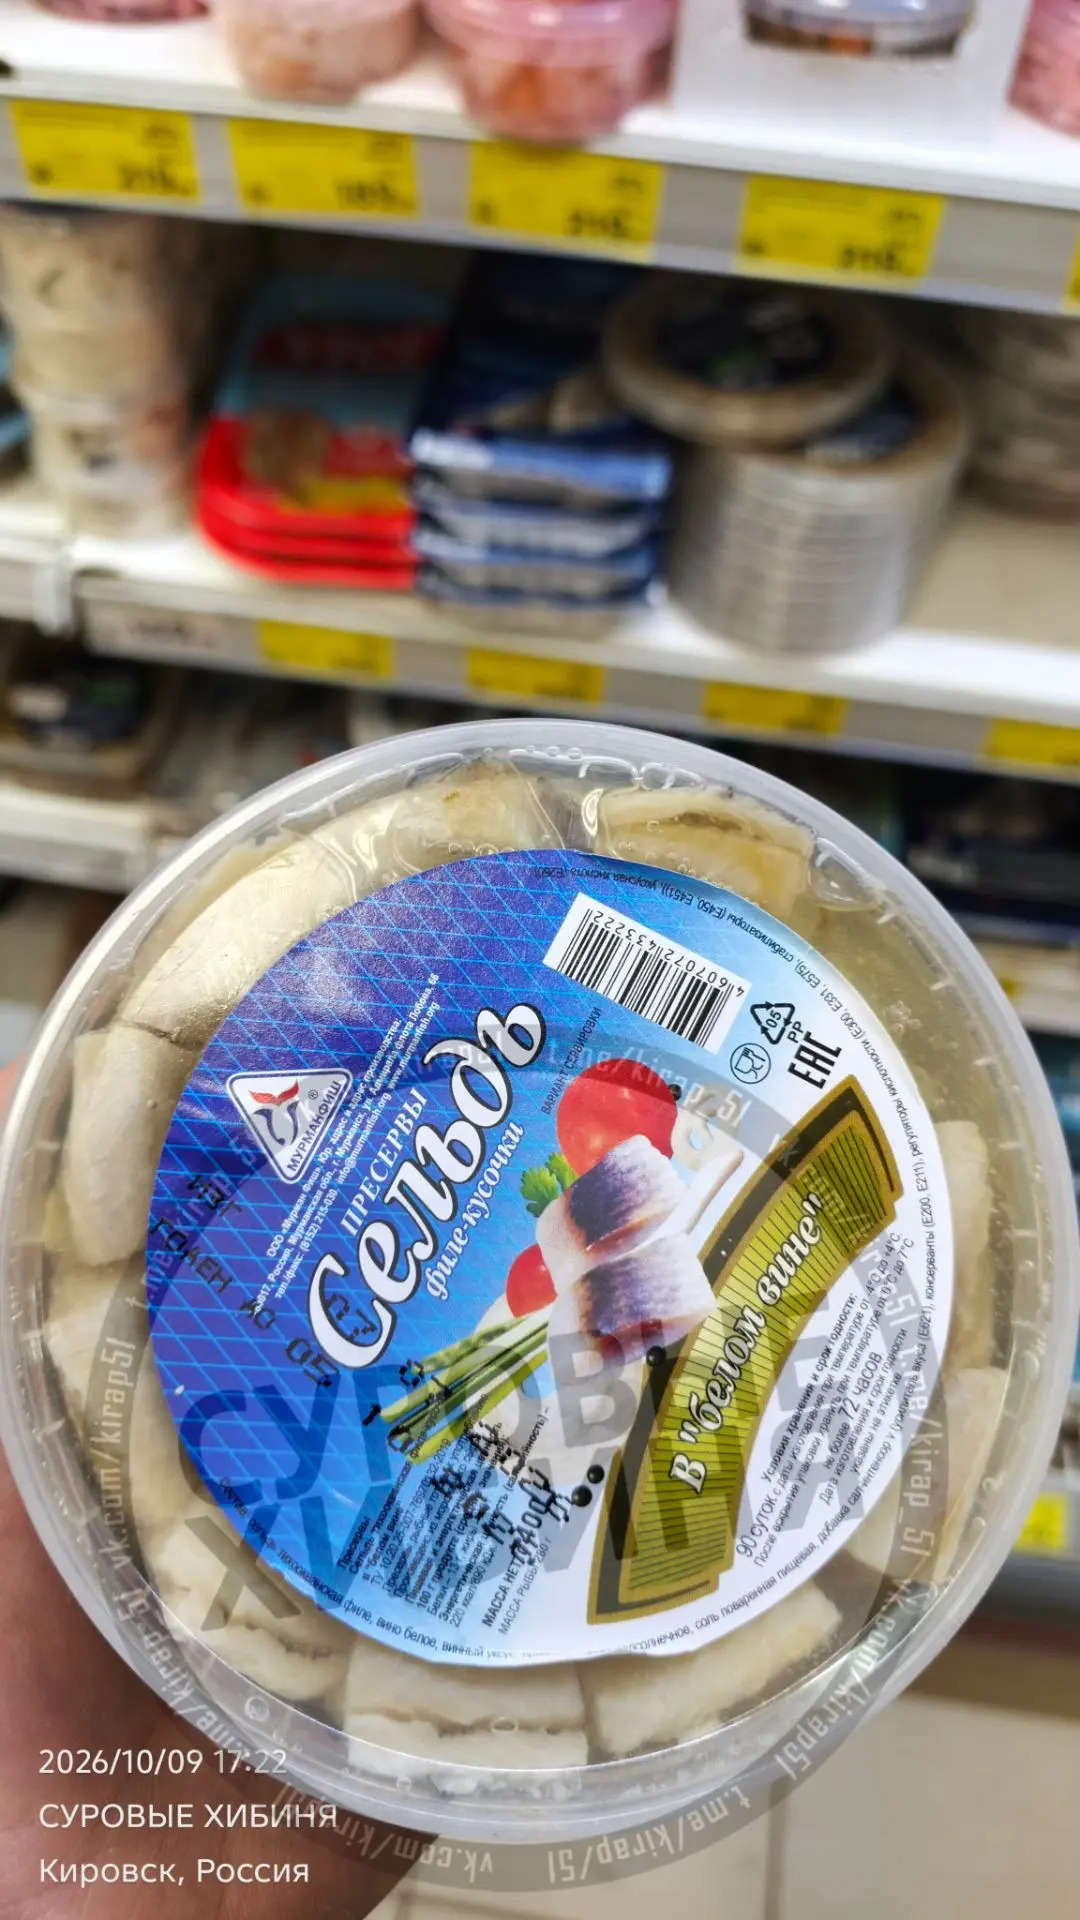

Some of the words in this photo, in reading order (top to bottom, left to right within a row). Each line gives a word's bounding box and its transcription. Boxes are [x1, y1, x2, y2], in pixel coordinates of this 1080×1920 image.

[725, 910, 796, 962] стабилизаторы
[766, 1010, 782, 1028] 05
[541, 1069, 571, 1115] ВАРИАНТ
[563, 1006, 603, 1070] СЕРВИРОВКИ
[859, 1038, 899, 1097] кислотности
[266, 1233, 284, 1256] ООО
[279, 1192, 307, 1234] «Мурман
[317, 1144, 333, 1163] Юр.
[329, 1118, 349, 1145] адрес
[348, 1082, 369, 1109] адрес
[362, 1018, 405, 1083] производства:
[268, 1244, 294, 1282] Россия,
[288, 1189, 325, 1245] Мурманская
[368, 1049, 399, 1095] Адмирала
[393, 1020, 415, 1050] флота
[285, 1081, 343, 1171] МУРМАНФИШ
[299, 1222, 321, 1251] (8152)
[334, 1091, 392, 1184] info@murmanfish.org
[385, 1001, 440, 1089] www.murmanfish.org
[892, 1097, 922, 1156] регуляторы
[308, 1003, 547, 1369] Сельдь
[340, 1088, 429, 1237] ПРЕСЕРВЫ
[426, 1121, 523, 1300] филе-кусочки
[922, 1230, 937, 1300] консерванты
[675, 1305, 768, 1447] "белом
[753, 1191, 834, 1309] вине"
[911, 1342, 930, 1372] вкуса
[735, 1534, 757, 1557] 90
[749, 1494, 781, 1539] суток
[775, 1460, 795, 1488] даты
[820, 1373, 836, 1393] при
[829, 1310, 865, 1372] температуре
[875, 1258, 889, 1273] до
[753, 1532, 777, 1567] После
[770, 1480, 802, 1532] вскрытия
[793, 1435, 824, 1483] упаковки
[815, 1394, 843, 1436] хранить
[834, 1372, 852, 1394] при
[843, 1307, 883, 1373] температуре
[890, 1257, 906, 1274] до
[760, 1434, 791, 1482] Условия
[783, 1381, 816, 1434] хранения
[813, 1345, 833, 1372] срок
[826, 1292, 858, 1345] годности:
[837, 1396, 859, 1419] 72
[818, 1476, 840, 1504] Дата
[832, 1407, 870, 1475] изготовления
[869, 1374, 887, 1398] срок
[879, 1327, 908, 1373] годности
[827, 1421, 849, 1453] более
[821, 1454, 834, 1468] не
[849, 1431, 876, 1474] указаны
[868, 1415, 881, 1430] на
[337, 1514, 370, 1569] Пресервы
[404, 1556, 435, 1604] Пищевая
[434, 1468, 480, 1548] энергетическая
[408, 1502, 436, 1543] рыбные
[813, 1502, 852, 1543] добавка
[349, 1534, 375, 1575] Сельдь
[439, 1540, 486, 1621] Энергетическая
[774, 1539, 819, 1579] пищевая,
[342, 1597, 376, 1625] филе,
[416, 1590, 431, 1609] 100
[426, 1584, 448, 1615] Белки
[481, 1583, 510, 1626] МАССА
[496, 1595, 523, 1634] МАССА
[693, 1610, 720, 1630] соль
[718, 1576, 779, 1618] поваренная
[375, 1616, 402, 1635] вино
[402, 1625, 440, 1650] белое,
[441, 1637, 484, 1660] винный
